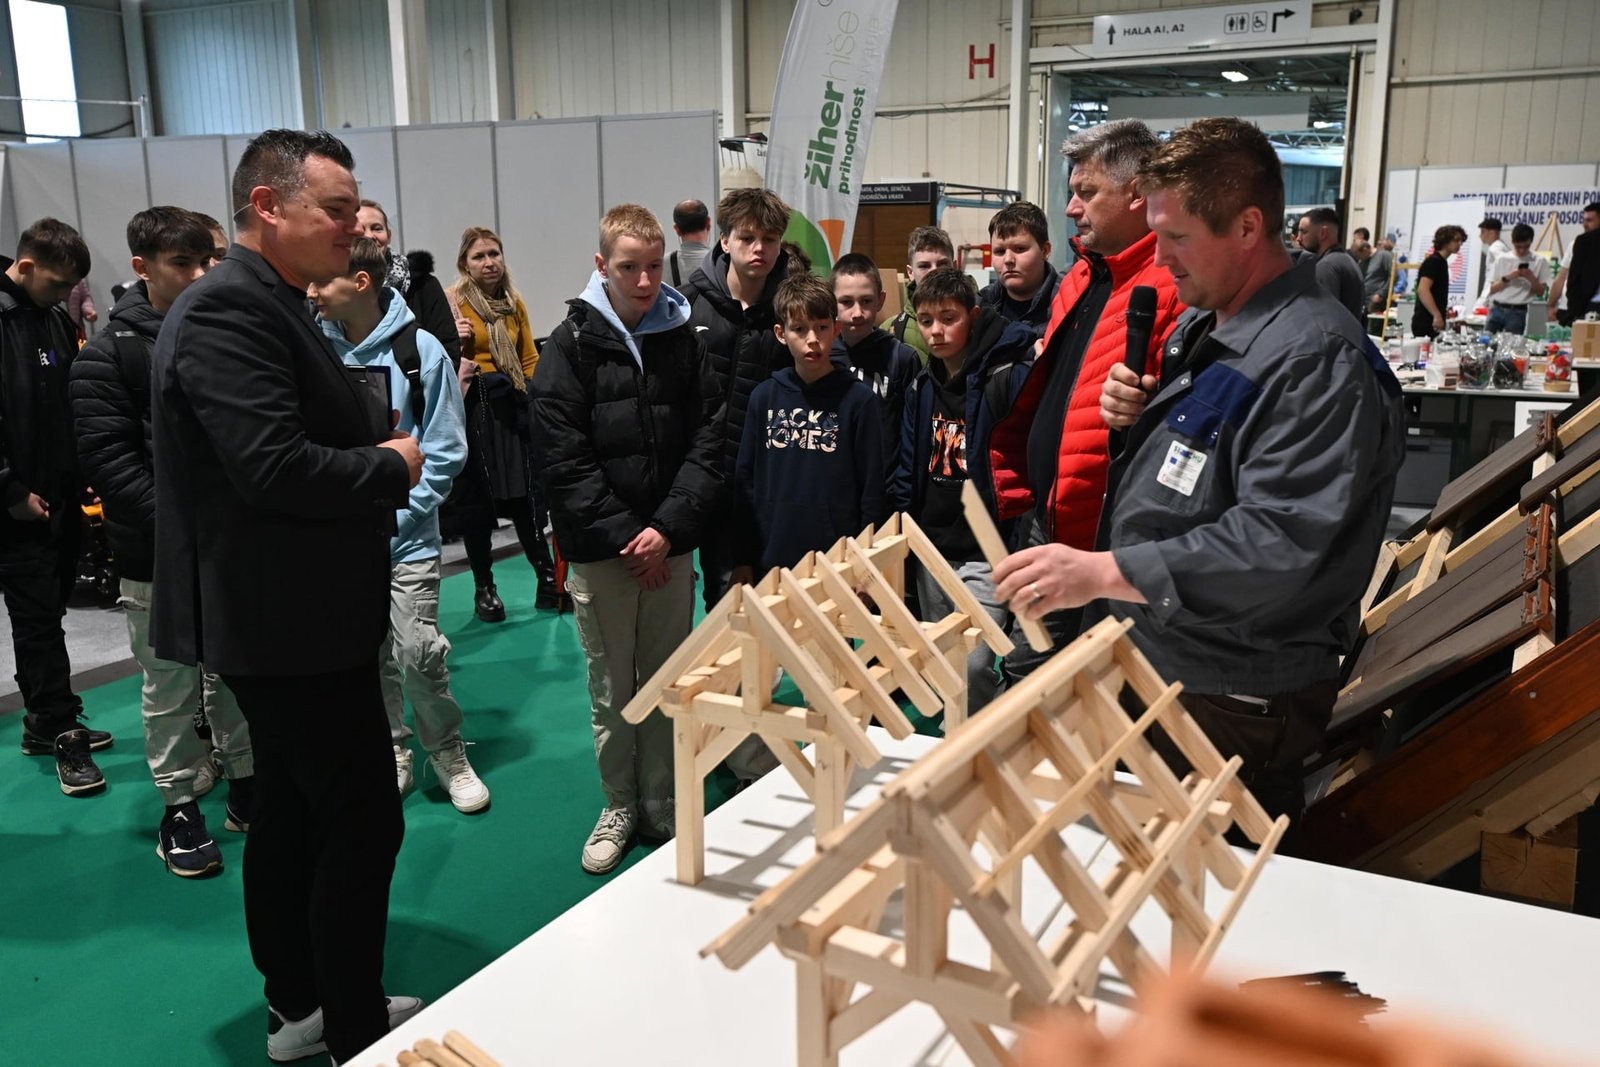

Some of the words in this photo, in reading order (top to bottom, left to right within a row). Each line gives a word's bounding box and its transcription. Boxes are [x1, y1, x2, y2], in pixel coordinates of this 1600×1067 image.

[1123, 26, 1151, 36] HALA
[1171, 23, 1185, 32] A2
[969, 43, 995, 79] H
[1523, 191, 1581, 206] GRADBENIH
[766, 428, 837, 452] JONES
